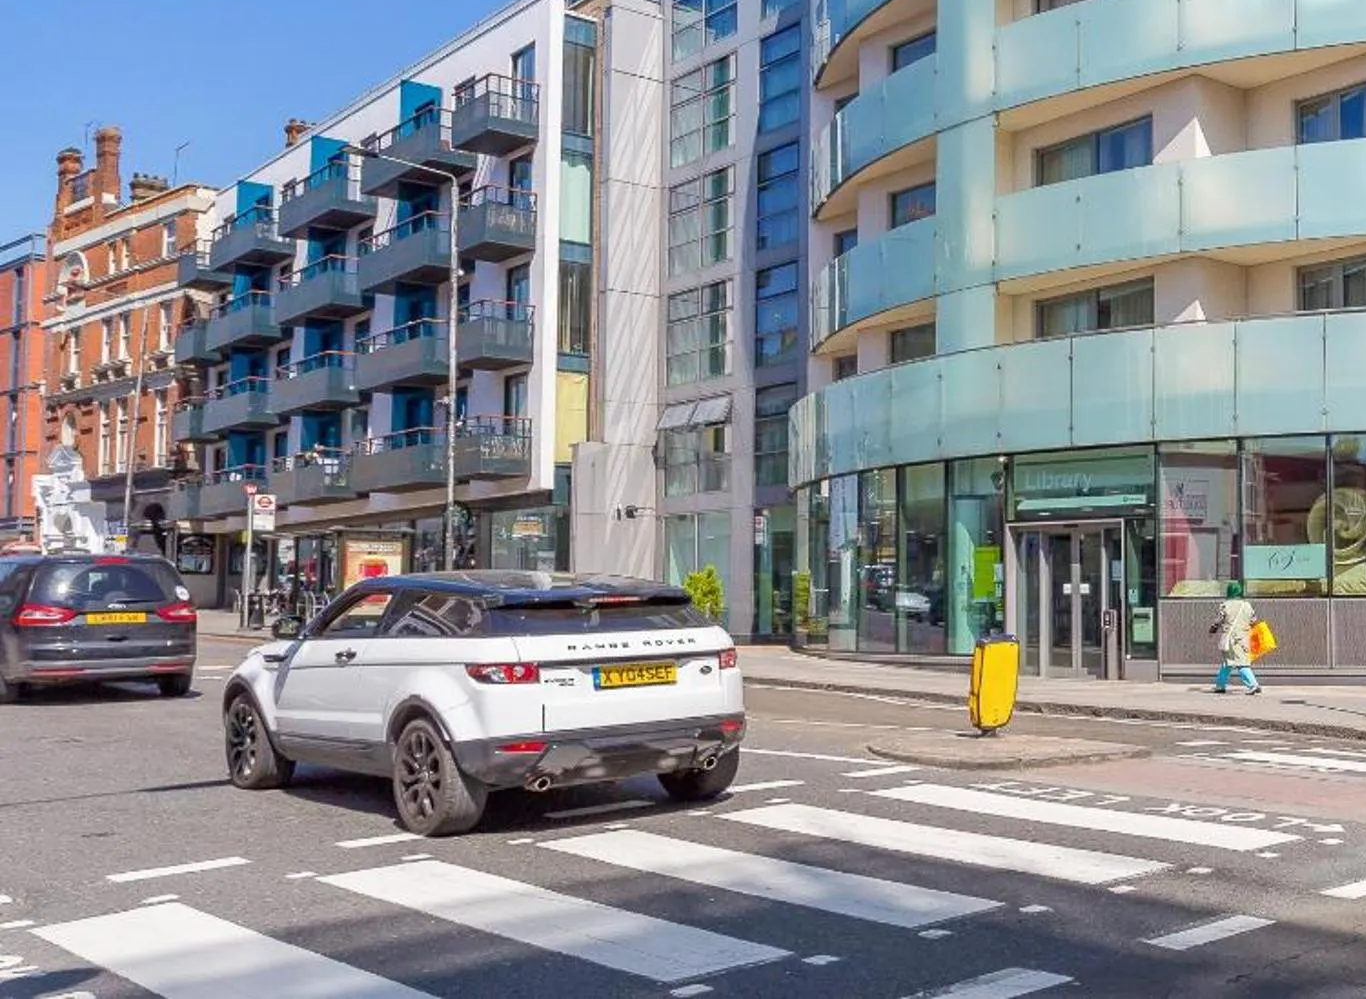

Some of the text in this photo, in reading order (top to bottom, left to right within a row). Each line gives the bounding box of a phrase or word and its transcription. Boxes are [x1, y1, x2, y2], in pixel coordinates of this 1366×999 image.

[1025, 470, 1093, 493] Library
[567, 637, 696, 651] RANGE ROVER
[968, 781, 1306, 830] LOOK LEFT
